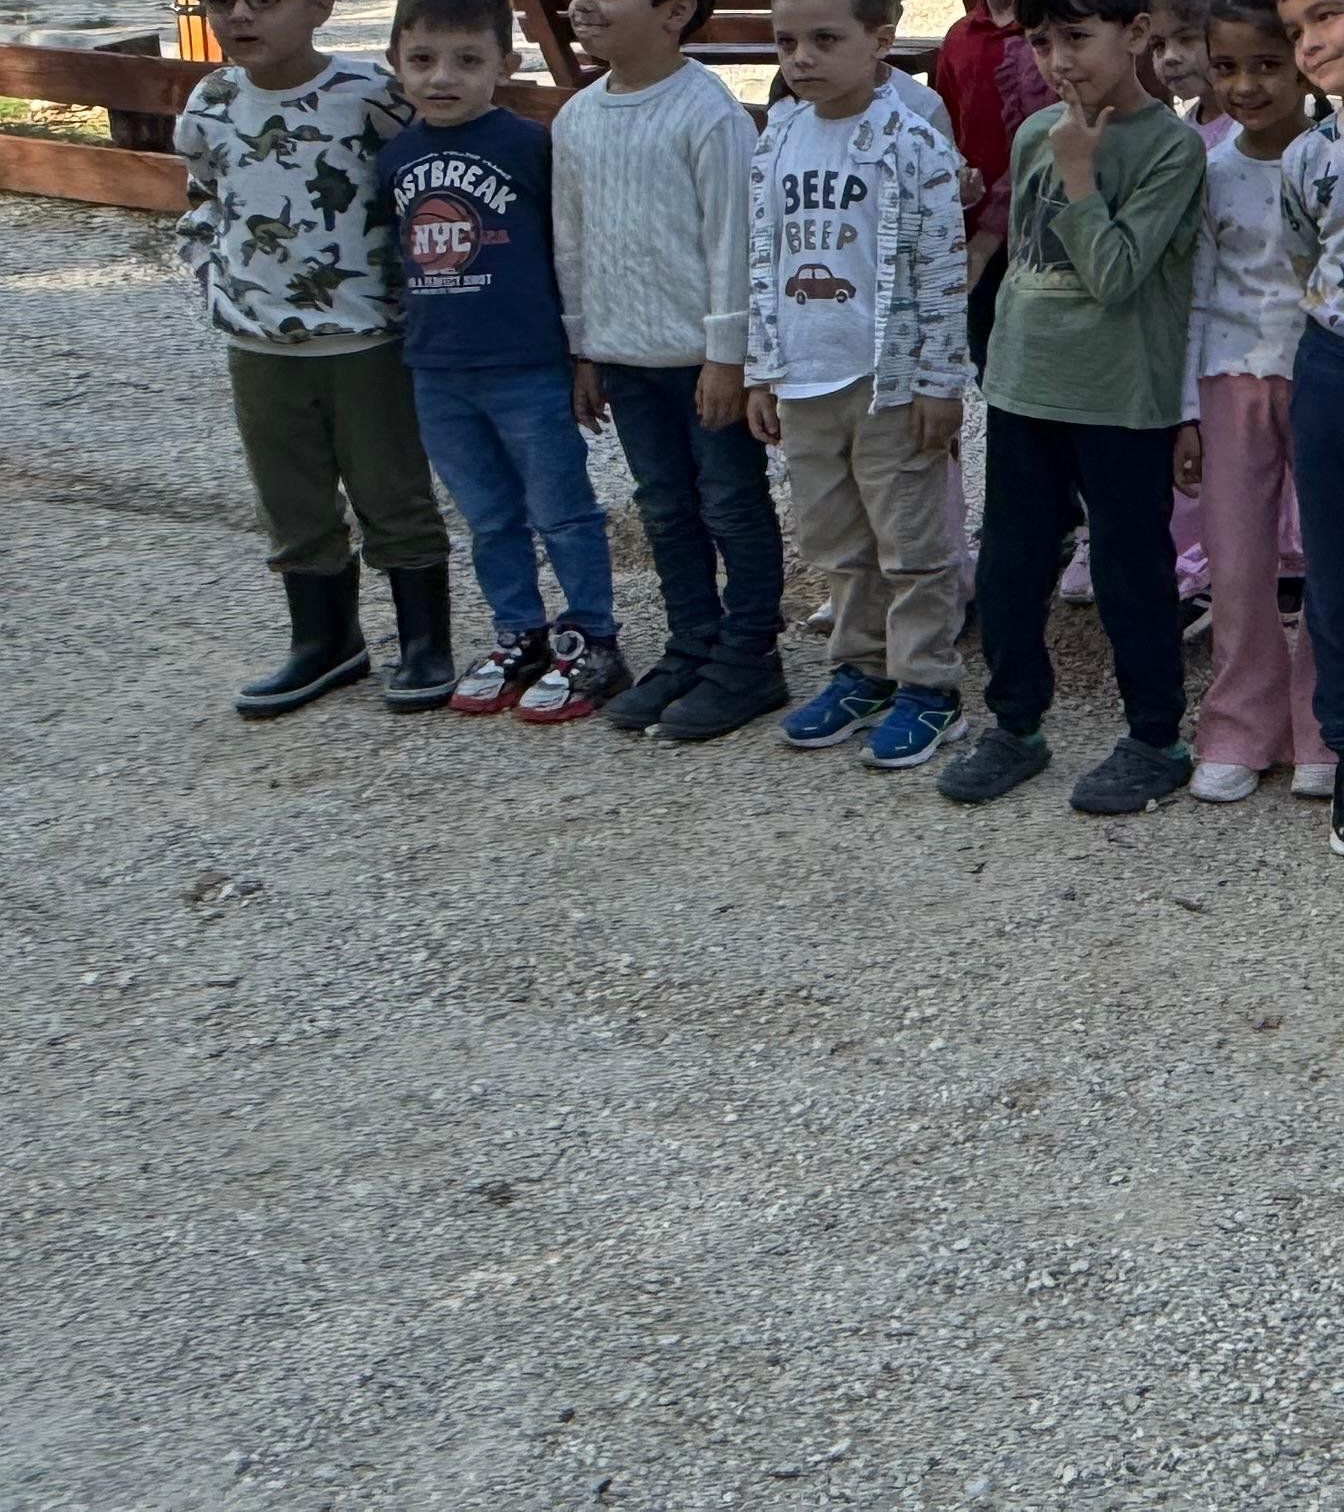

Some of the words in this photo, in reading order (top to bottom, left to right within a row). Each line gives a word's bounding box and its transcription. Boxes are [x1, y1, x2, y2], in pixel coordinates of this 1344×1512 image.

[393, 160, 518, 218] ASTBREAK
[782, 169, 868, 216] BEEP
[412, 221, 473, 256] NYC
[785, 219, 858, 255] BEEP
